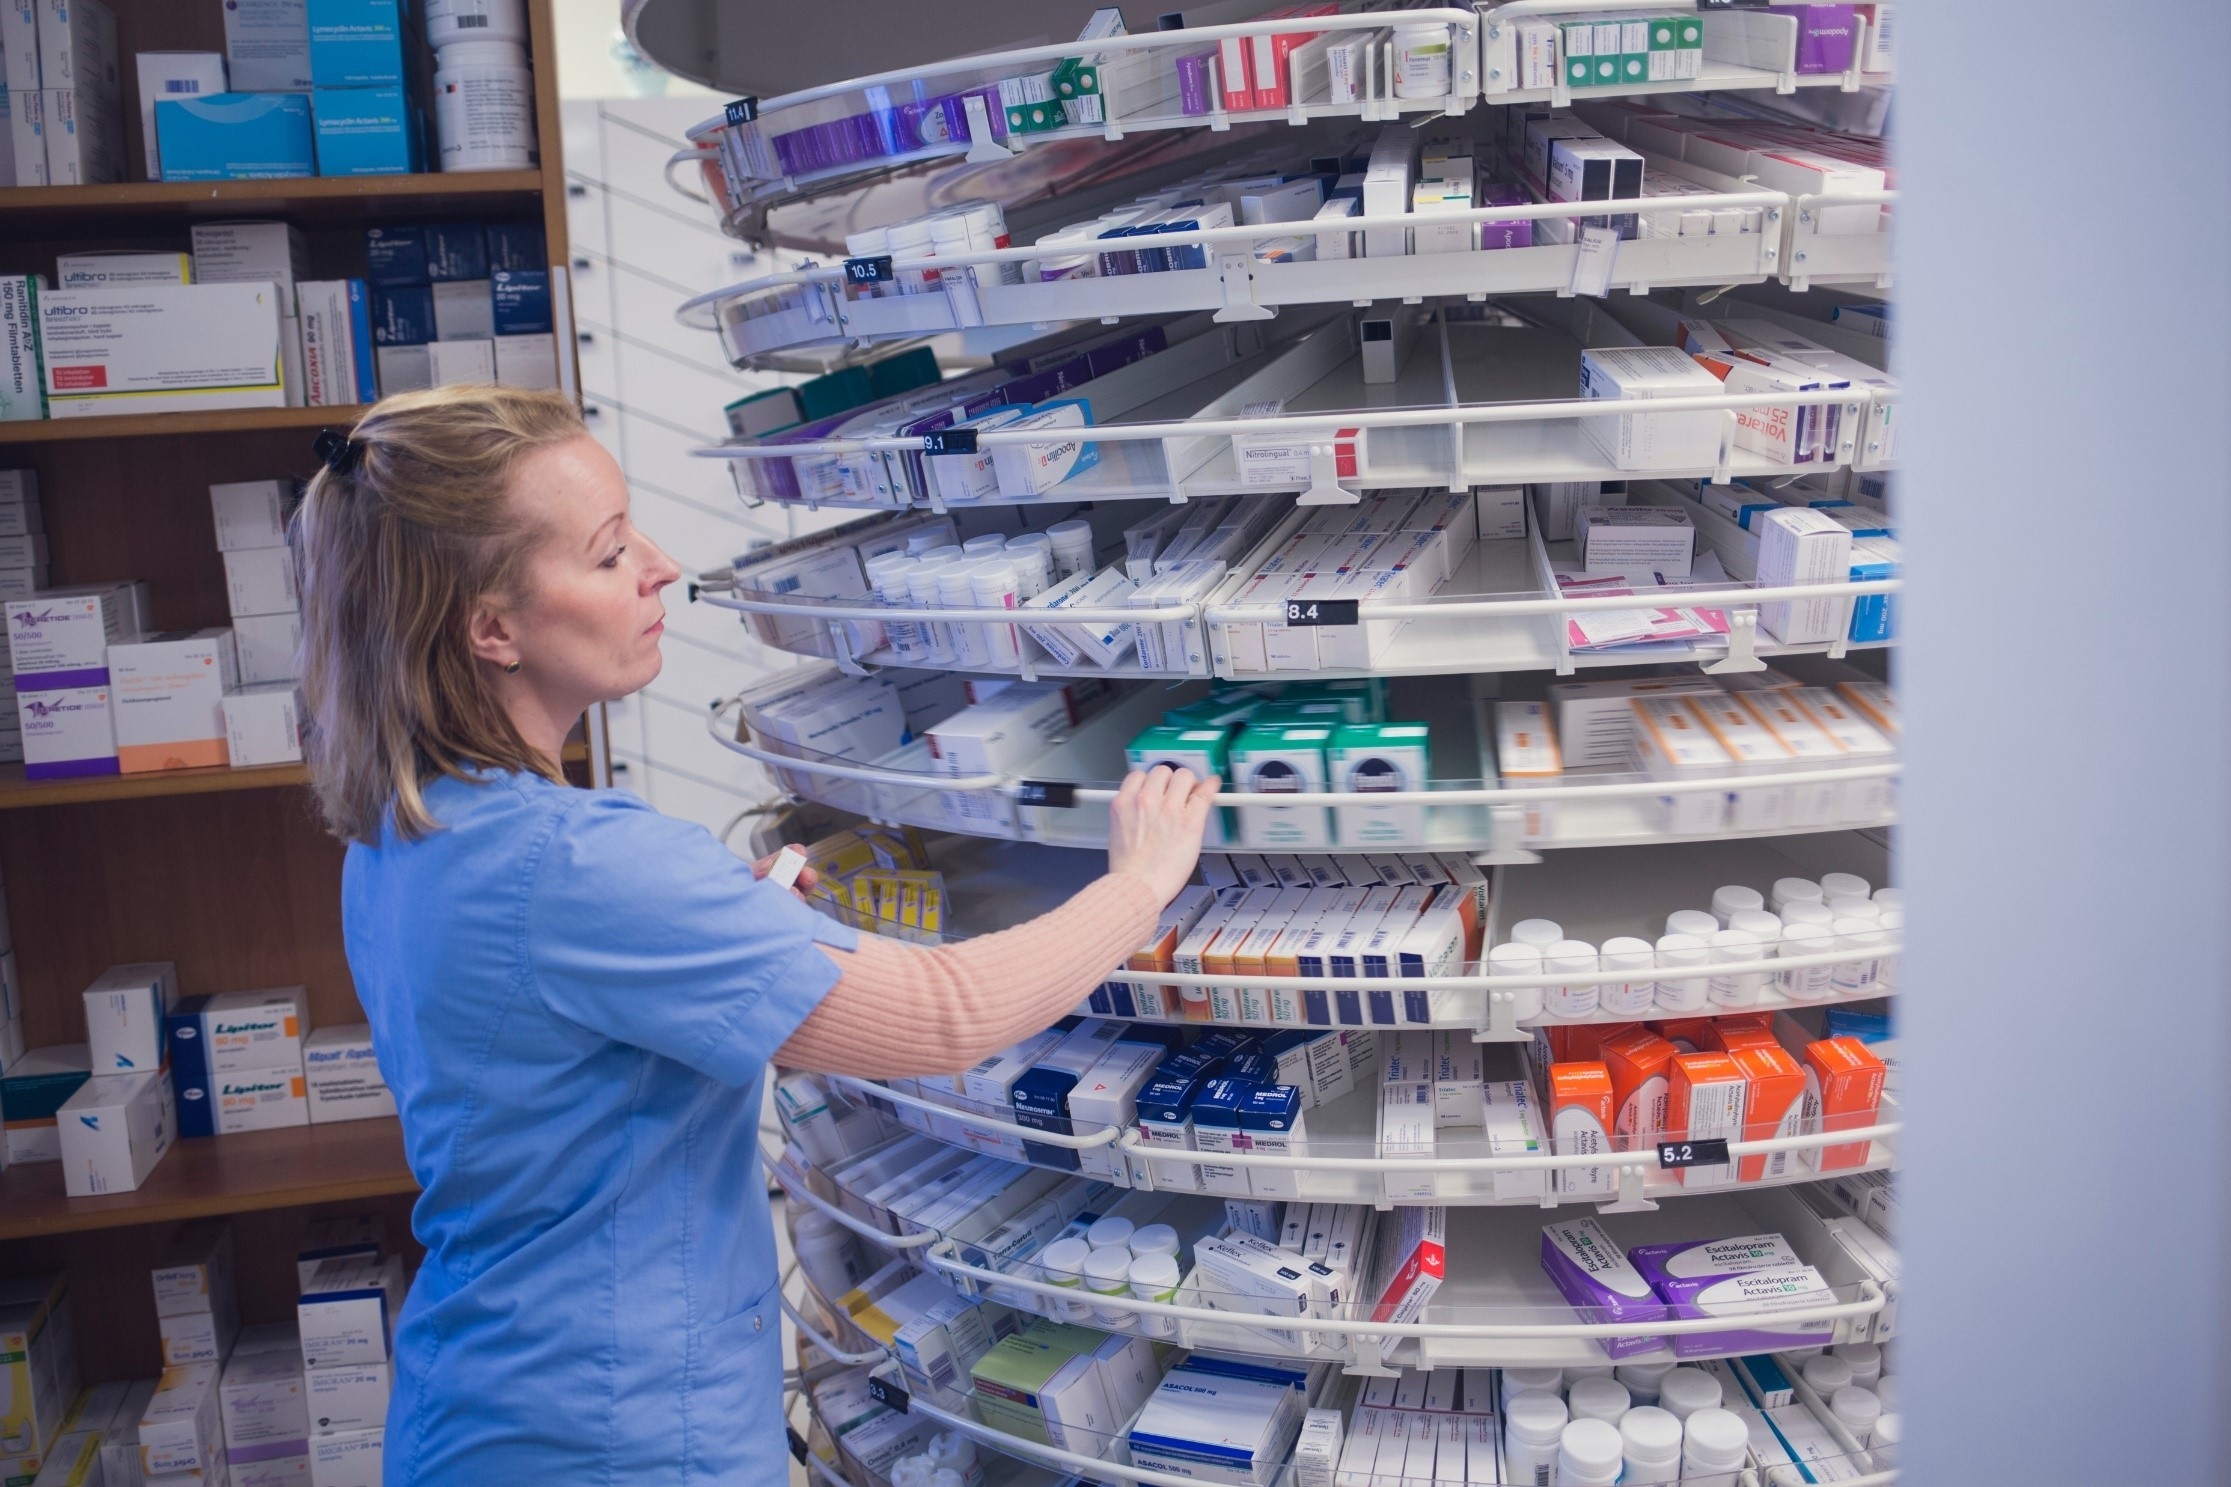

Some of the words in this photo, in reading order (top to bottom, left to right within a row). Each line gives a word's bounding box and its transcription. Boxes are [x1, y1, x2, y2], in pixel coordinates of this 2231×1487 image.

[1818, 27, 1849, 36] Apodorm
[728, 107, 745, 120] 11.4
[64, 271, 107, 282] ultibro
[851, 263, 877, 279] 10.5
[3, 281, 14, 300] 150
[495, 284, 542, 292] Lipitor
[4, 301, 15, 320] mg
[16, 280, 29, 329] Ranitidin
[44, 304, 88, 317] ultibro
[8, 322, 24, 394] Filmtabletten
[308, 346, 323, 406] ARCOXIA
[1773, 409, 1789, 425] 25
[1736, 412, 1786, 443] Voltare
[924, 436, 945, 450] 9.1
[1245, 449, 1290, 459] Nitrolingual
[1288, 603, 1319, 619] 8.4
[1881, 607, 1889, 622] 200
[1110, 626, 1120, 638] mg
[1877, 622, 1885, 634] mg
[13, 631, 43, 641] 50/500
[1045, 641, 1070, 665] Cordarone
[1138, 637, 1149, 669] Cordarone
[25, 721, 54, 730] 50/500
[1478, 884, 1486, 921] Voltaren
[1138, 984, 1149, 1016] Voltare
[1148, 994, 1154, 1005] mg
[1212, 987, 1222, 1019] Voltare
[1221, 998, 1228, 1008] mg
[1242, 988, 1251, 1020] Voltare
[1252, 999, 1259, 1009] mg
[1273, 989, 1282, 1020] Voltare
[1284, 999, 1291, 1010] mg
[1148, 1005, 1154, 1016] 50
[1221, 1009, 1228, 1019] 50
[1252, 1010, 1259, 1020] 50
[1284, 1010, 1291, 1021] 50
[214, 1021, 278, 1035] Lipitor
[215, 1036, 230, 1046] 80
[231, 1036, 249, 1046] mg
[1388, 1056, 1401, 1082] Triatec
[1438, 1056, 1451, 1082] Triatec
[222, 1081, 285, 1095] Lipitor
[1153, 1083, 1183, 1091] MEDROL
[1213, 1080, 1230, 1099] MEDROL
[1255, 1090, 1288, 1098] MEDROL
[1512, 1081, 1526, 1107] Triatec
[223, 1097, 237, 1107] 80
[238, 1095, 256, 1106] mg
[1017, 1114, 1030, 1122] 300
[1031, 1117, 1044, 1126] mg
[1151, 1131, 1181, 1139] MEDROL
[1255, 1140, 1287, 1148] MEDROL
[1663, 1145, 1693, 1163] 5.2
[992, 1228, 1034, 1261] Terra-Cortril
[1216, 1243, 1244, 1258] Keflex
[1248, 1237, 1276, 1253] Keflex
[1562, 1229, 1600, 1273] Escitalopram
[1704, 1240, 1775, 1254] Escitalopram
[1588, 1240, 1613, 1269] Actavis
[1711, 1251, 1750, 1262] Actavis
[1736, 1274, 1808, 1287] Escitalopram
[1743, 1286, 1783, 1296] Actavis
[1783, 1283, 1797, 1291] 10
[304, 1338, 346, 1348] IMIGRAN
[346, 1337, 357, 1346] 20
[358, 1337, 369, 1346] mg
[1616, 1338, 1642, 1348] Actavis
[312, 1376, 353, 1387] IMIGRAN
[354, 1375, 365, 1383] 20
[366, 1375, 377, 1384] mg
[1162, 1382, 1194, 1392] ASACOL
[869, 1383, 886, 1400] 3.3
[317, 1444, 358, 1456] IMIGRAN
[359, 1442, 370, 1450] 20
[371, 1441, 382, 1450] mg
[867, 1450, 892, 1466] Omnic
[906, 1435, 919, 1446] mg
[1137, 1459, 1168, 1471] ASACOL
[1168, 1465, 1181, 1473] 500
[1181, 1468, 1192, 1476] mg
